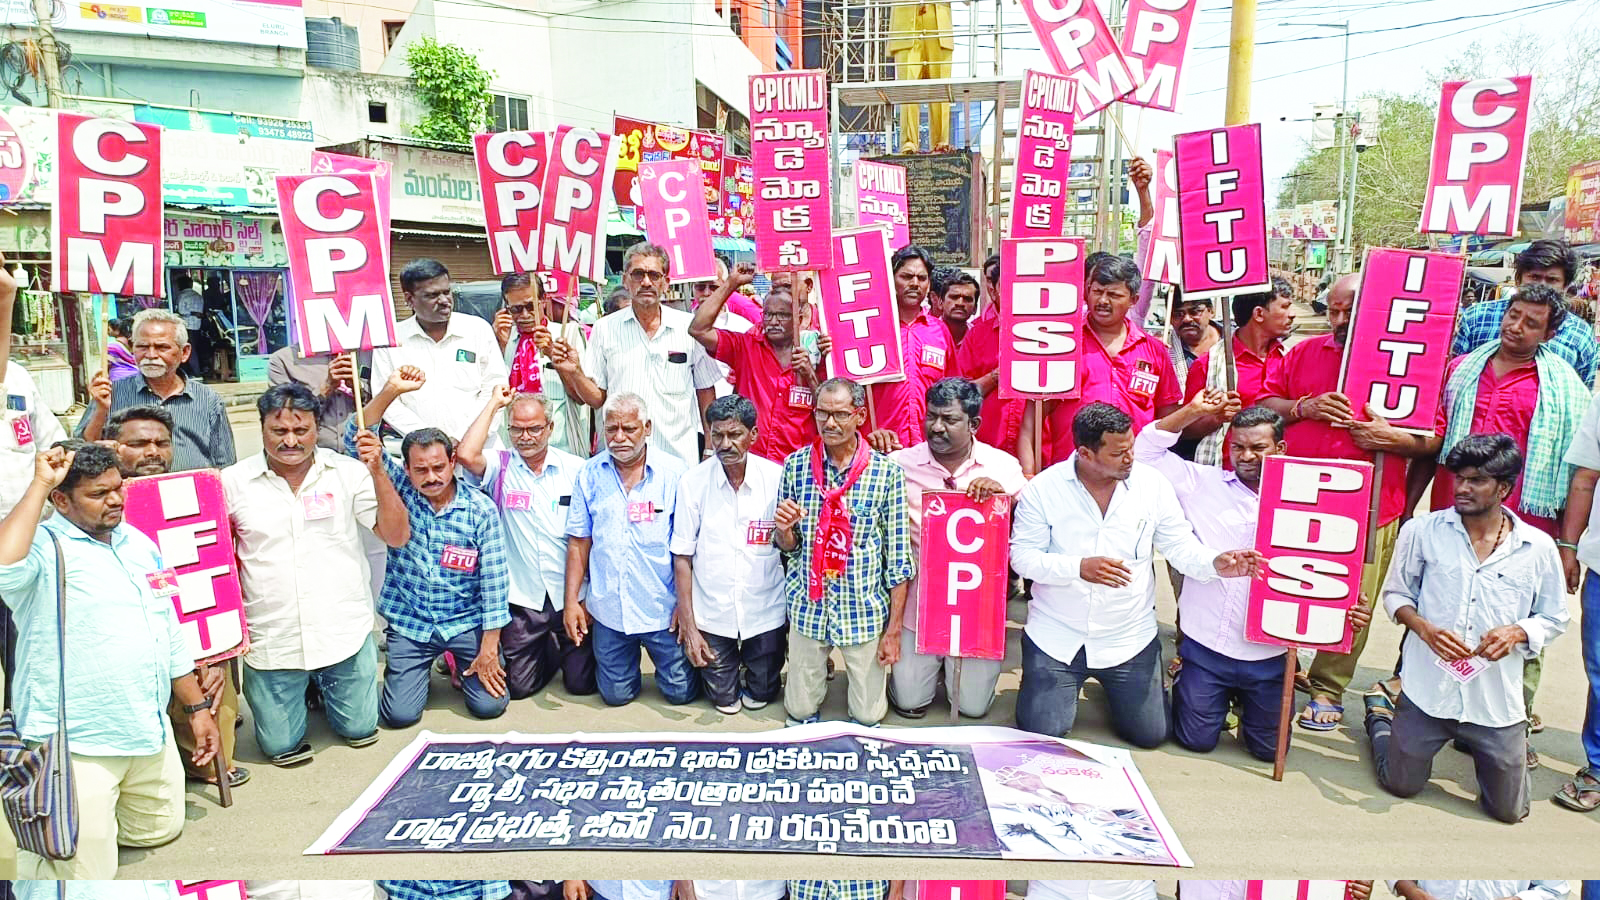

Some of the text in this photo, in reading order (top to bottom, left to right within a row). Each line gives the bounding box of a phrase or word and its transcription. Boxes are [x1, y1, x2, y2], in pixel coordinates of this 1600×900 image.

[1122, 0, 1187, 108] PM
[752, 78, 823, 114] CPI(ML)
[1028, 75, 1075, 114] CPI(ML)
[404, 168, 472, 201] మందుల
[859, 164, 905, 195] CPI(ML)
[1428, 78, 1520, 232] CPM
[67, 118, 154, 294] CPM
[486, 132, 541, 273] CPM
[543, 127, 602, 277] CPM
[657, 171, 691, 276] CPI
[1203, 131, 1247, 283] IFTU
[293, 176, 392, 353] CPM
[836, 236, 888, 376] IFTU
[1010, 241, 1078, 393] PDSU
[1368, 256, 1430, 419] IFTU
[922, 350, 945, 366] IFTU
[1130, 376, 1157, 395] IFTU
[790, 391, 812, 406] IFTU
[631, 514, 654, 522] CPI
[749, 528, 773, 541] IFT
[824, 550, 847, 561] CPM
[1260, 462, 1364, 644] PDSU
[157, 476, 243, 651] IFTU
[443, 551, 475, 568] IFTU
[946, 508, 985, 657] CPI
[418, 749, 557, 779] రాజ్యాంగం
[558, 747, 676, 776] కల్పించిన
[680, 747, 741, 772] భావ
[745, 747, 858, 773] ప్రకటనా
[449, 772, 528, 813] ర్యాలీ,
[531, 777, 600, 806] సభా
[807, 776, 916, 805] హరించే
[579, 807, 658, 840] జీవో
[662, 811, 717, 840] నెం.
[780, 809, 958, 853] రద్దుచేయాలి
